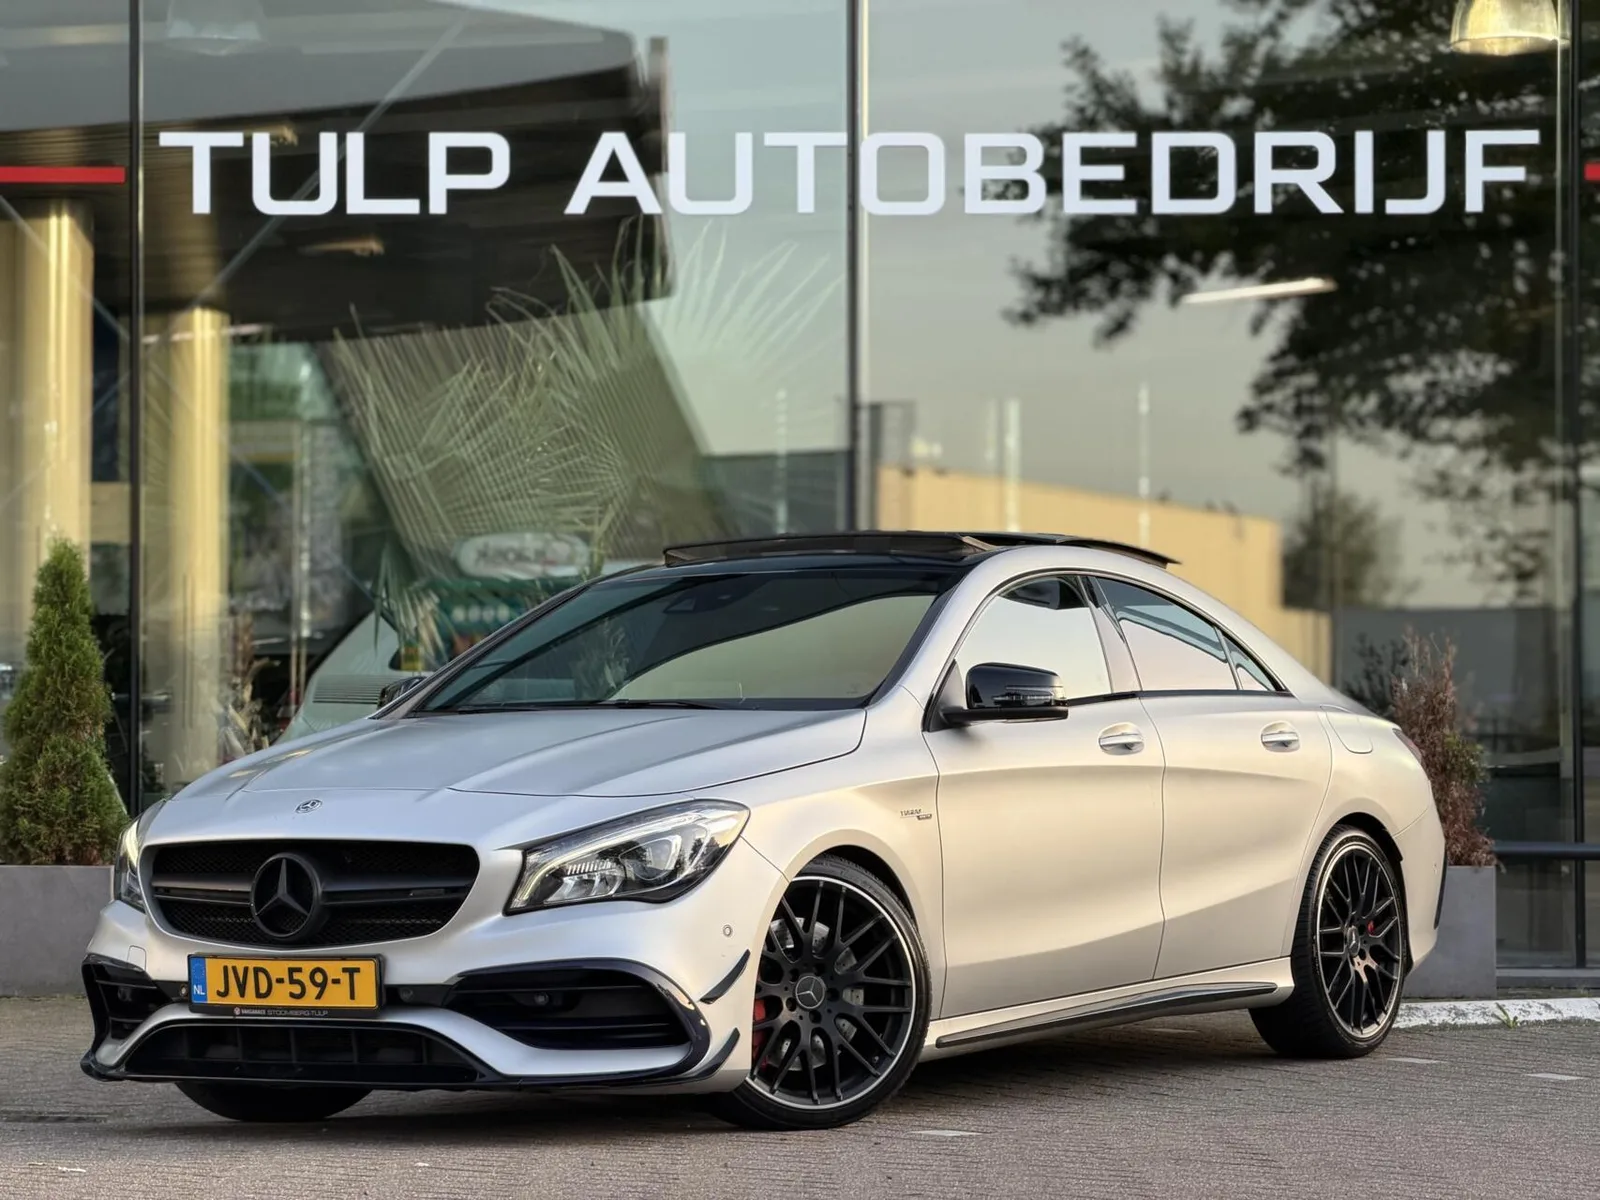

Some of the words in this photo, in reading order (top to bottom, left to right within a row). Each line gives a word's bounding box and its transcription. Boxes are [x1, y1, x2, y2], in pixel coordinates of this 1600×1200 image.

[159, 131, 510, 215] TULP
[565, 130, 1540, 216] AUTOBEDRIJF
[193, 985, 206, 995] NL
[216, 965, 361, 1001] JVD-59-T
